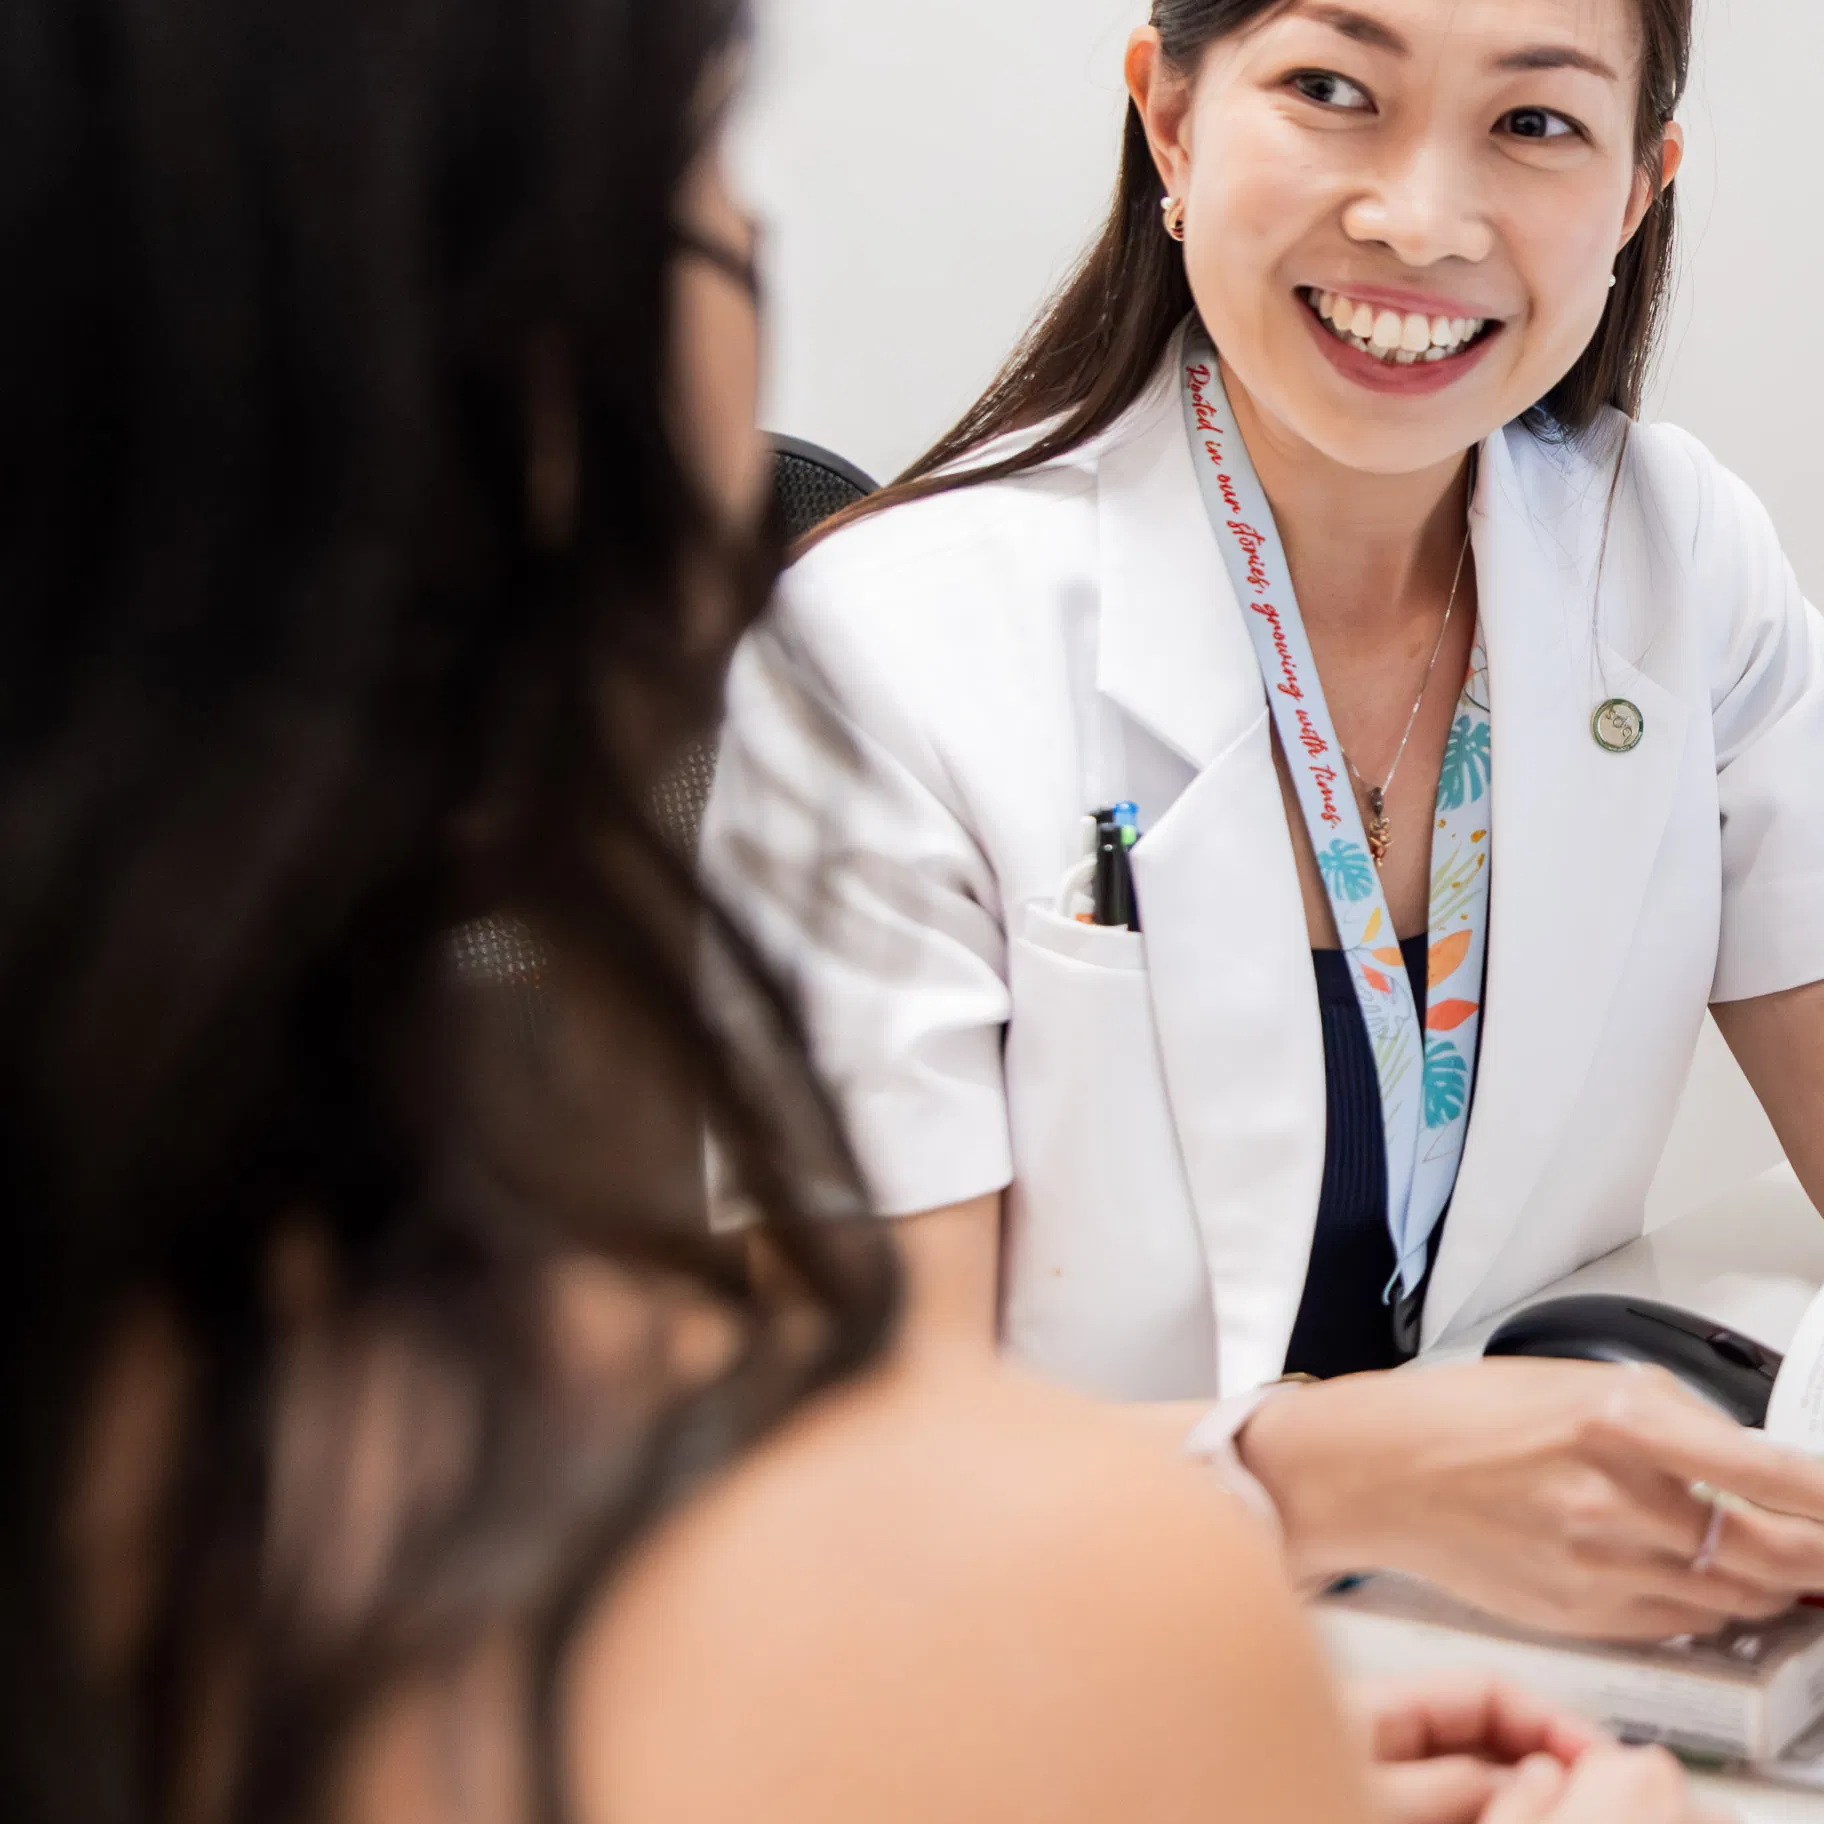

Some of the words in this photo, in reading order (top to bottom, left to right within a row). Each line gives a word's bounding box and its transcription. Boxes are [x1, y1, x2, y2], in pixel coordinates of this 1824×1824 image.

[1185, 363, 1223, 434] Rooted
[1205, 440, 1224, 466] in
[1217, 473, 1242, 515] our
[1250, 602, 1304, 702] growing
[1295, 708, 1328, 760] with
